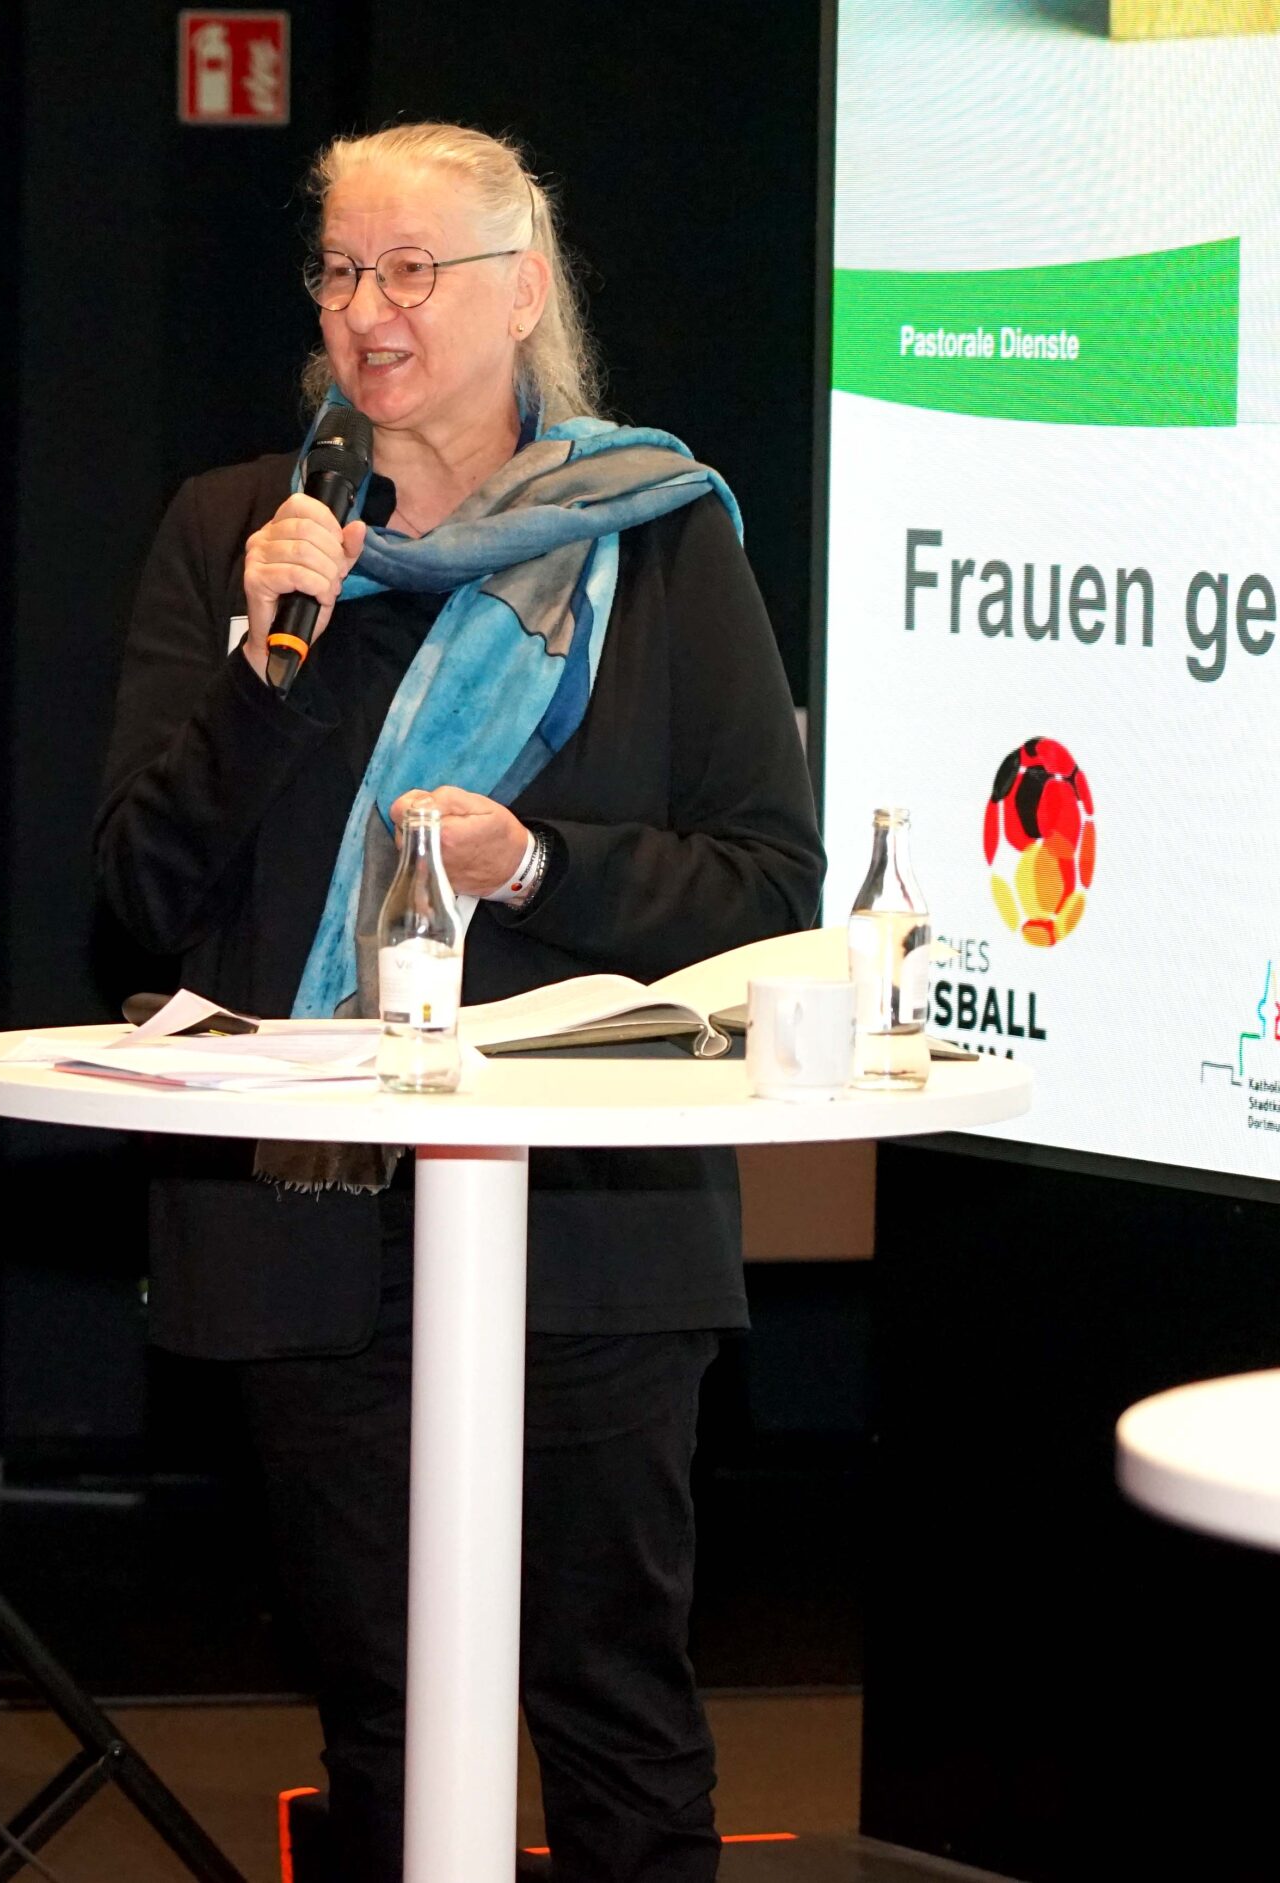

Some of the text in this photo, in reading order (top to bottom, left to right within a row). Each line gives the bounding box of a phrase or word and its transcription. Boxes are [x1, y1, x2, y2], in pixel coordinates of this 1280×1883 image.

[900, 325, 1079, 360] Pastorale Dienste
[904, 528, 1277, 683] Frauen ge
[926, 979, 1046, 1040] SBALL
